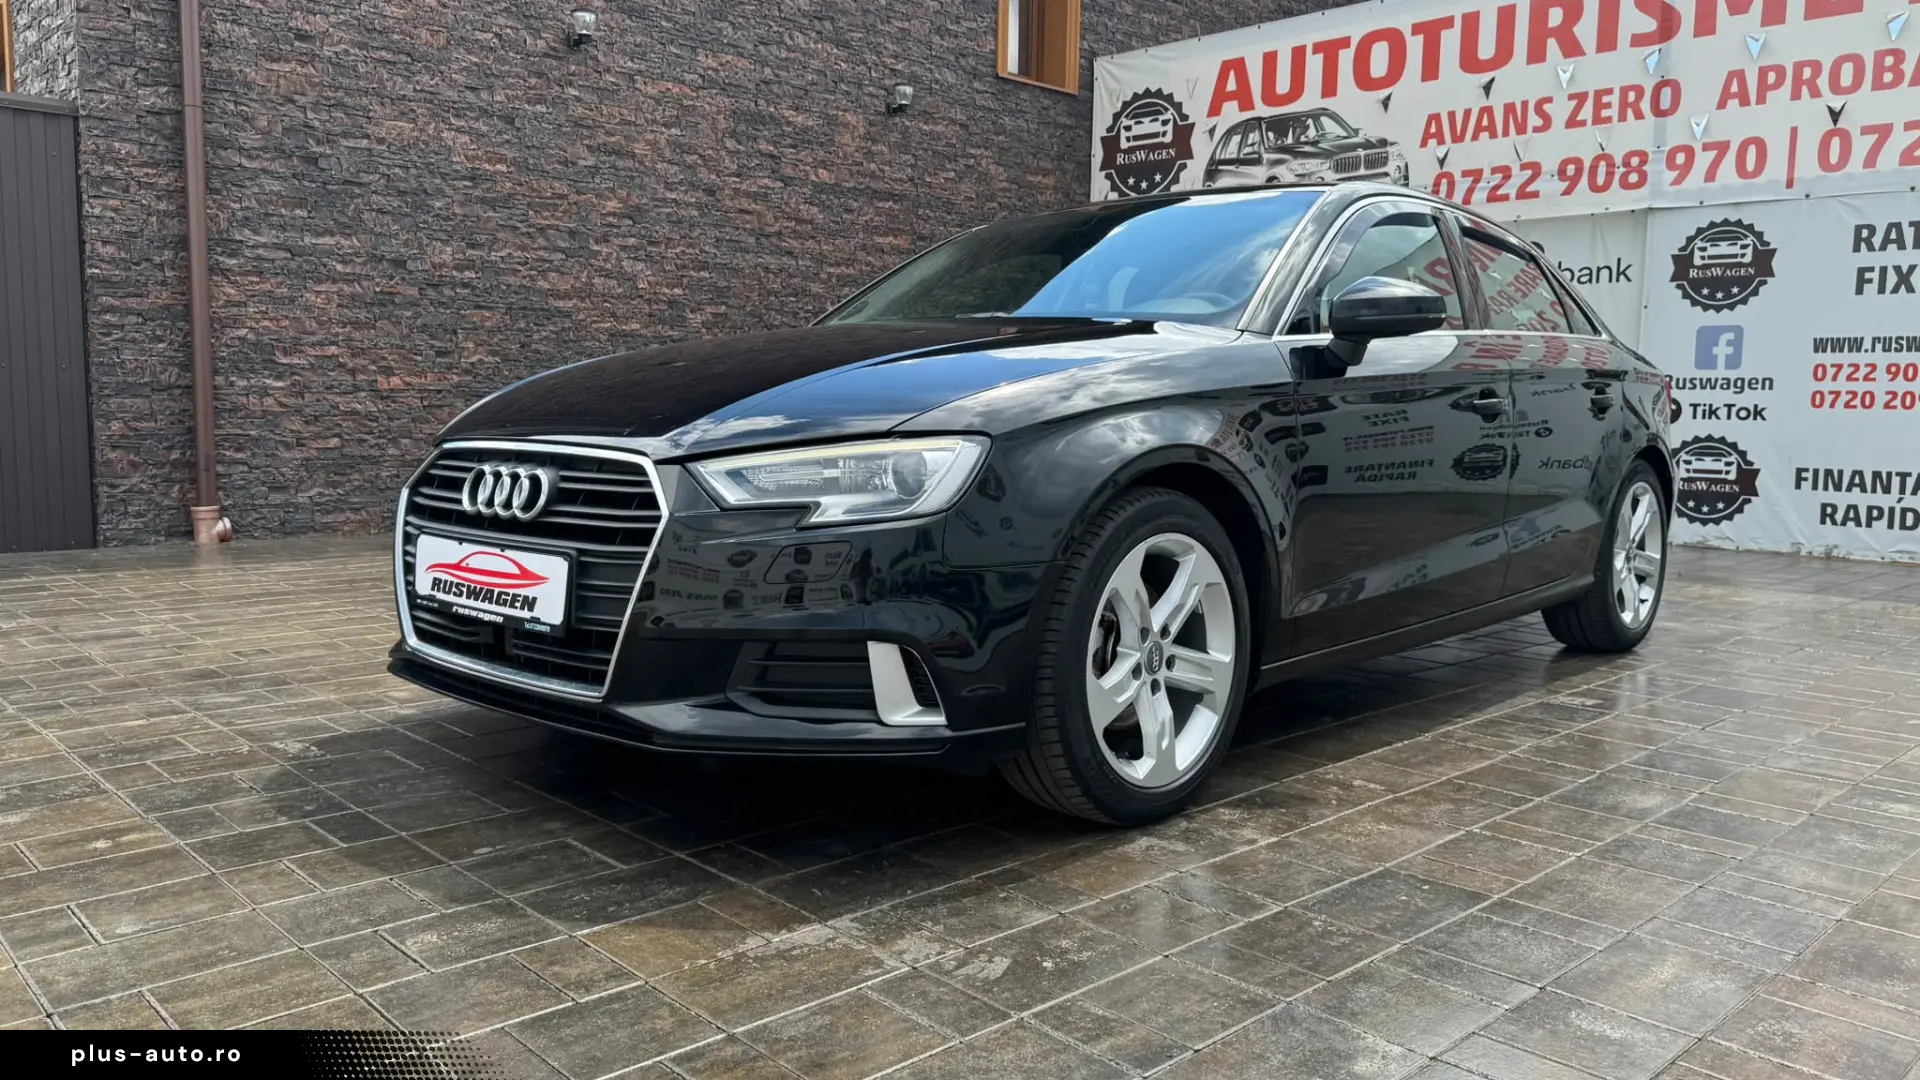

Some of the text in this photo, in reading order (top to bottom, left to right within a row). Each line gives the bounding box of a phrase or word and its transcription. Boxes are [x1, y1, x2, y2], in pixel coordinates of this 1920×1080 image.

[1206, 0, 1864, 118] AUTOTURIS
[1419, 96, 1554, 148] AVANS
[1564, 78, 1682, 130] ZERO
[1430, 160, 1542, 206] 0722
[1556, 149, 1649, 197] 908
[1664, 136, 1768, 187] 970
[1854, 264, 1919, 296] FIX
[1812, 362, 1878, 383] 0722
[1688, 403, 1768, 421] TikTok
[1810, 390, 1920, 411] 0720 20
[430, 577, 538, 612] RUSWAGEN
[452, 605, 504, 623] ruswagen
